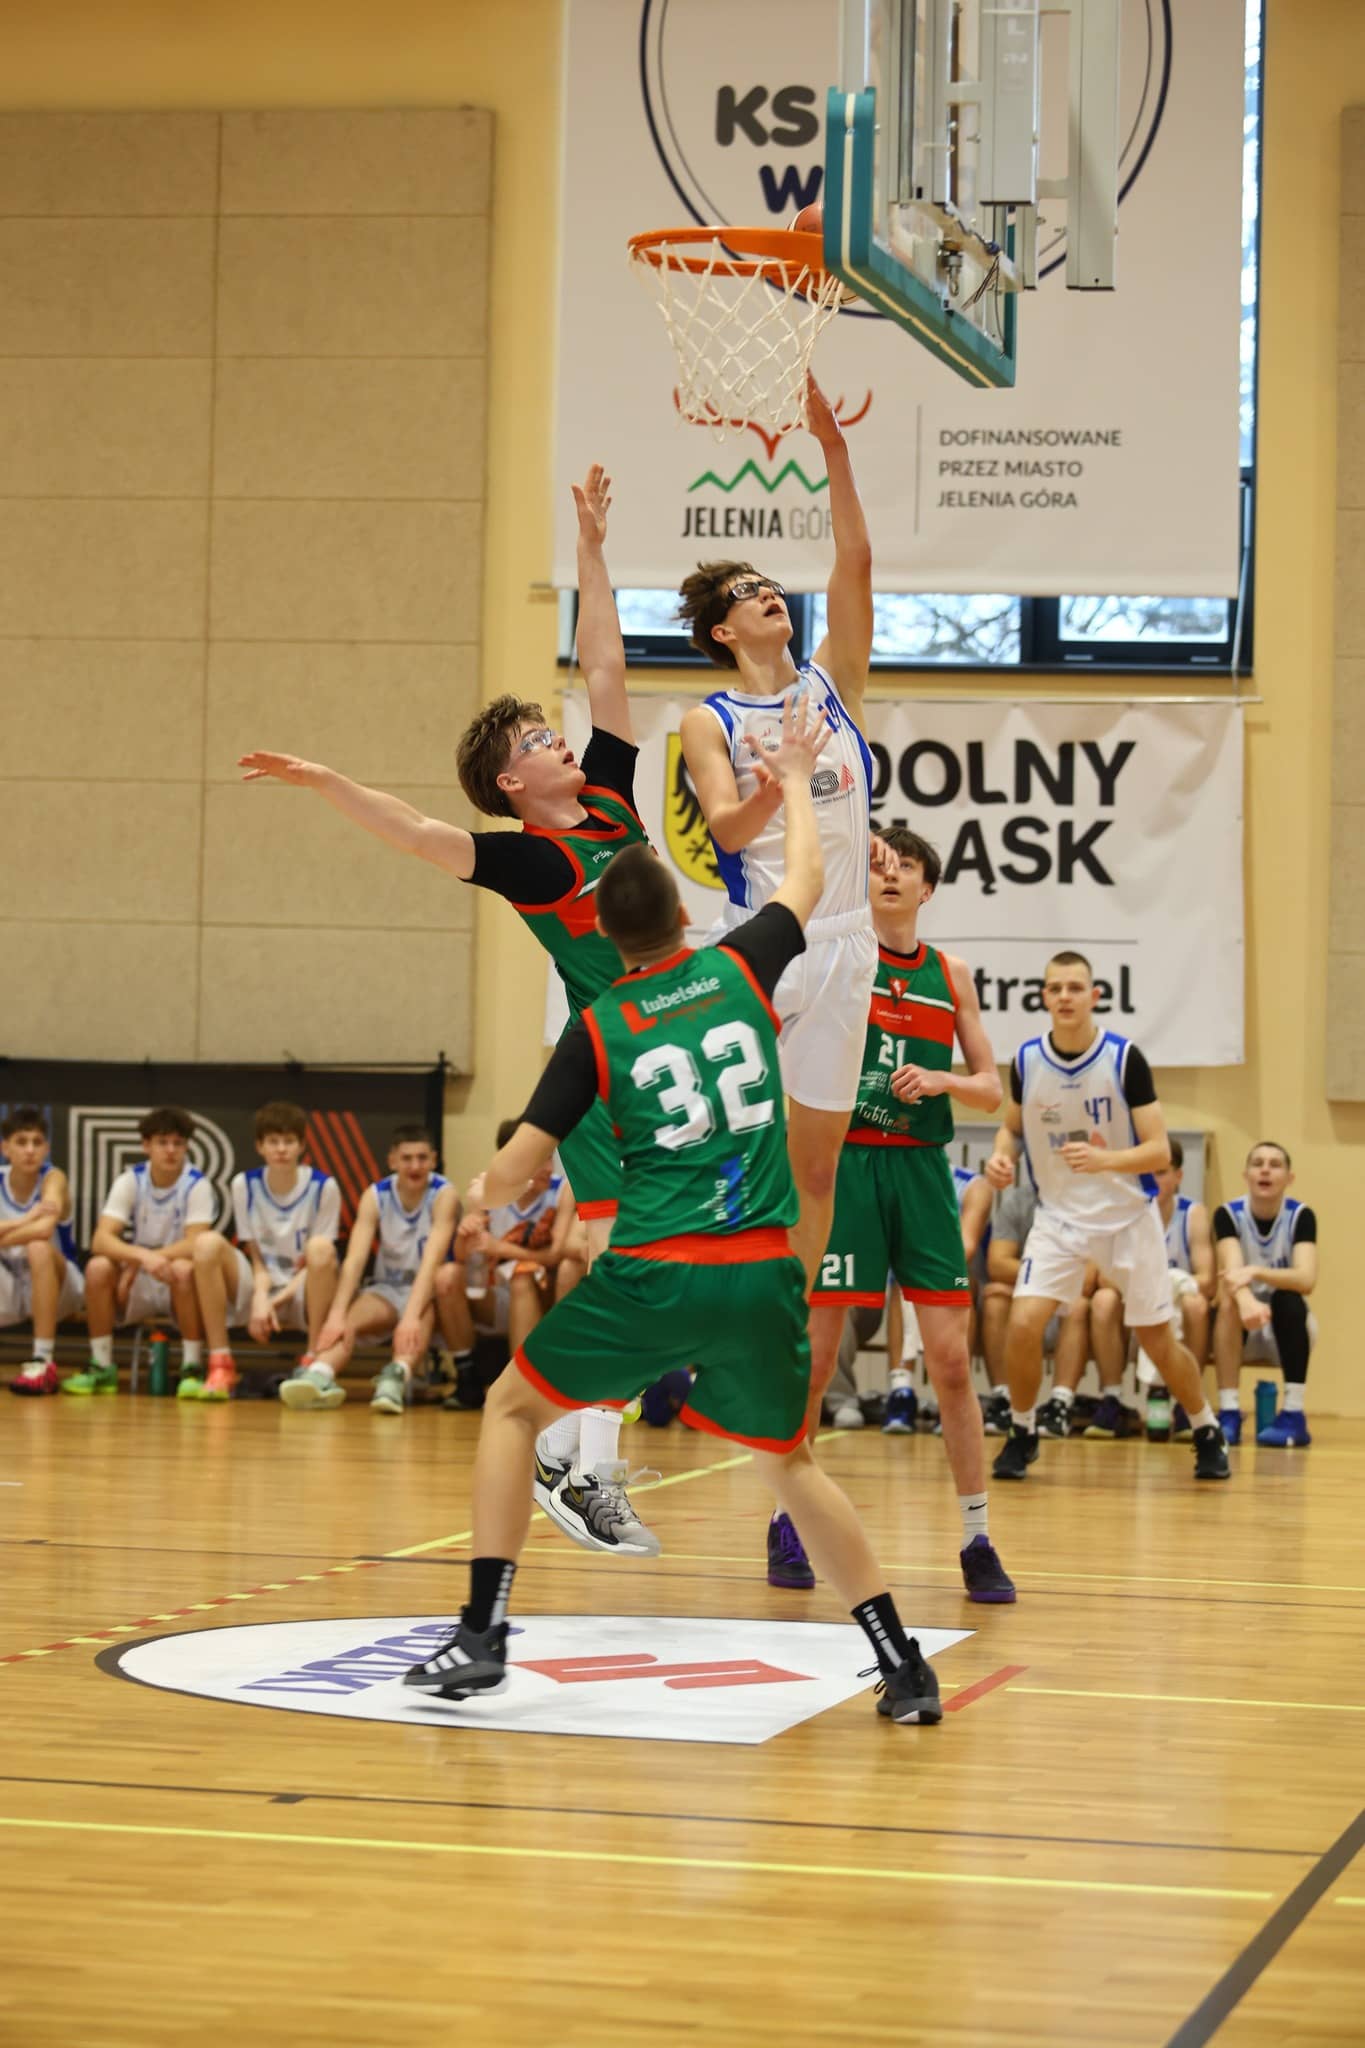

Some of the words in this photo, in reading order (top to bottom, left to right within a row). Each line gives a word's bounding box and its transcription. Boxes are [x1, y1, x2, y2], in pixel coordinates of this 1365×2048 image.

[715, 84, 820, 147] KS
[939, 430, 1121, 447] DOFINANSOWANE
[938, 460, 999, 477] PRZEZ
[1004, 460, 1083, 478] MIASTO
[937, 491, 1015, 508] JELENIA
[1020, 487, 1078, 508] GÓRA
[681, 507, 783, 538] JELENIA
[641, 976, 721, 1015] lubelskie
[974, 965, 1135, 1013] trael
[878, 1032, 907, 1068] 21
[630, 1020, 775, 1151] 32
[1084, 1096, 1112, 1126] 47
[821, 1253, 855, 1287] 21
